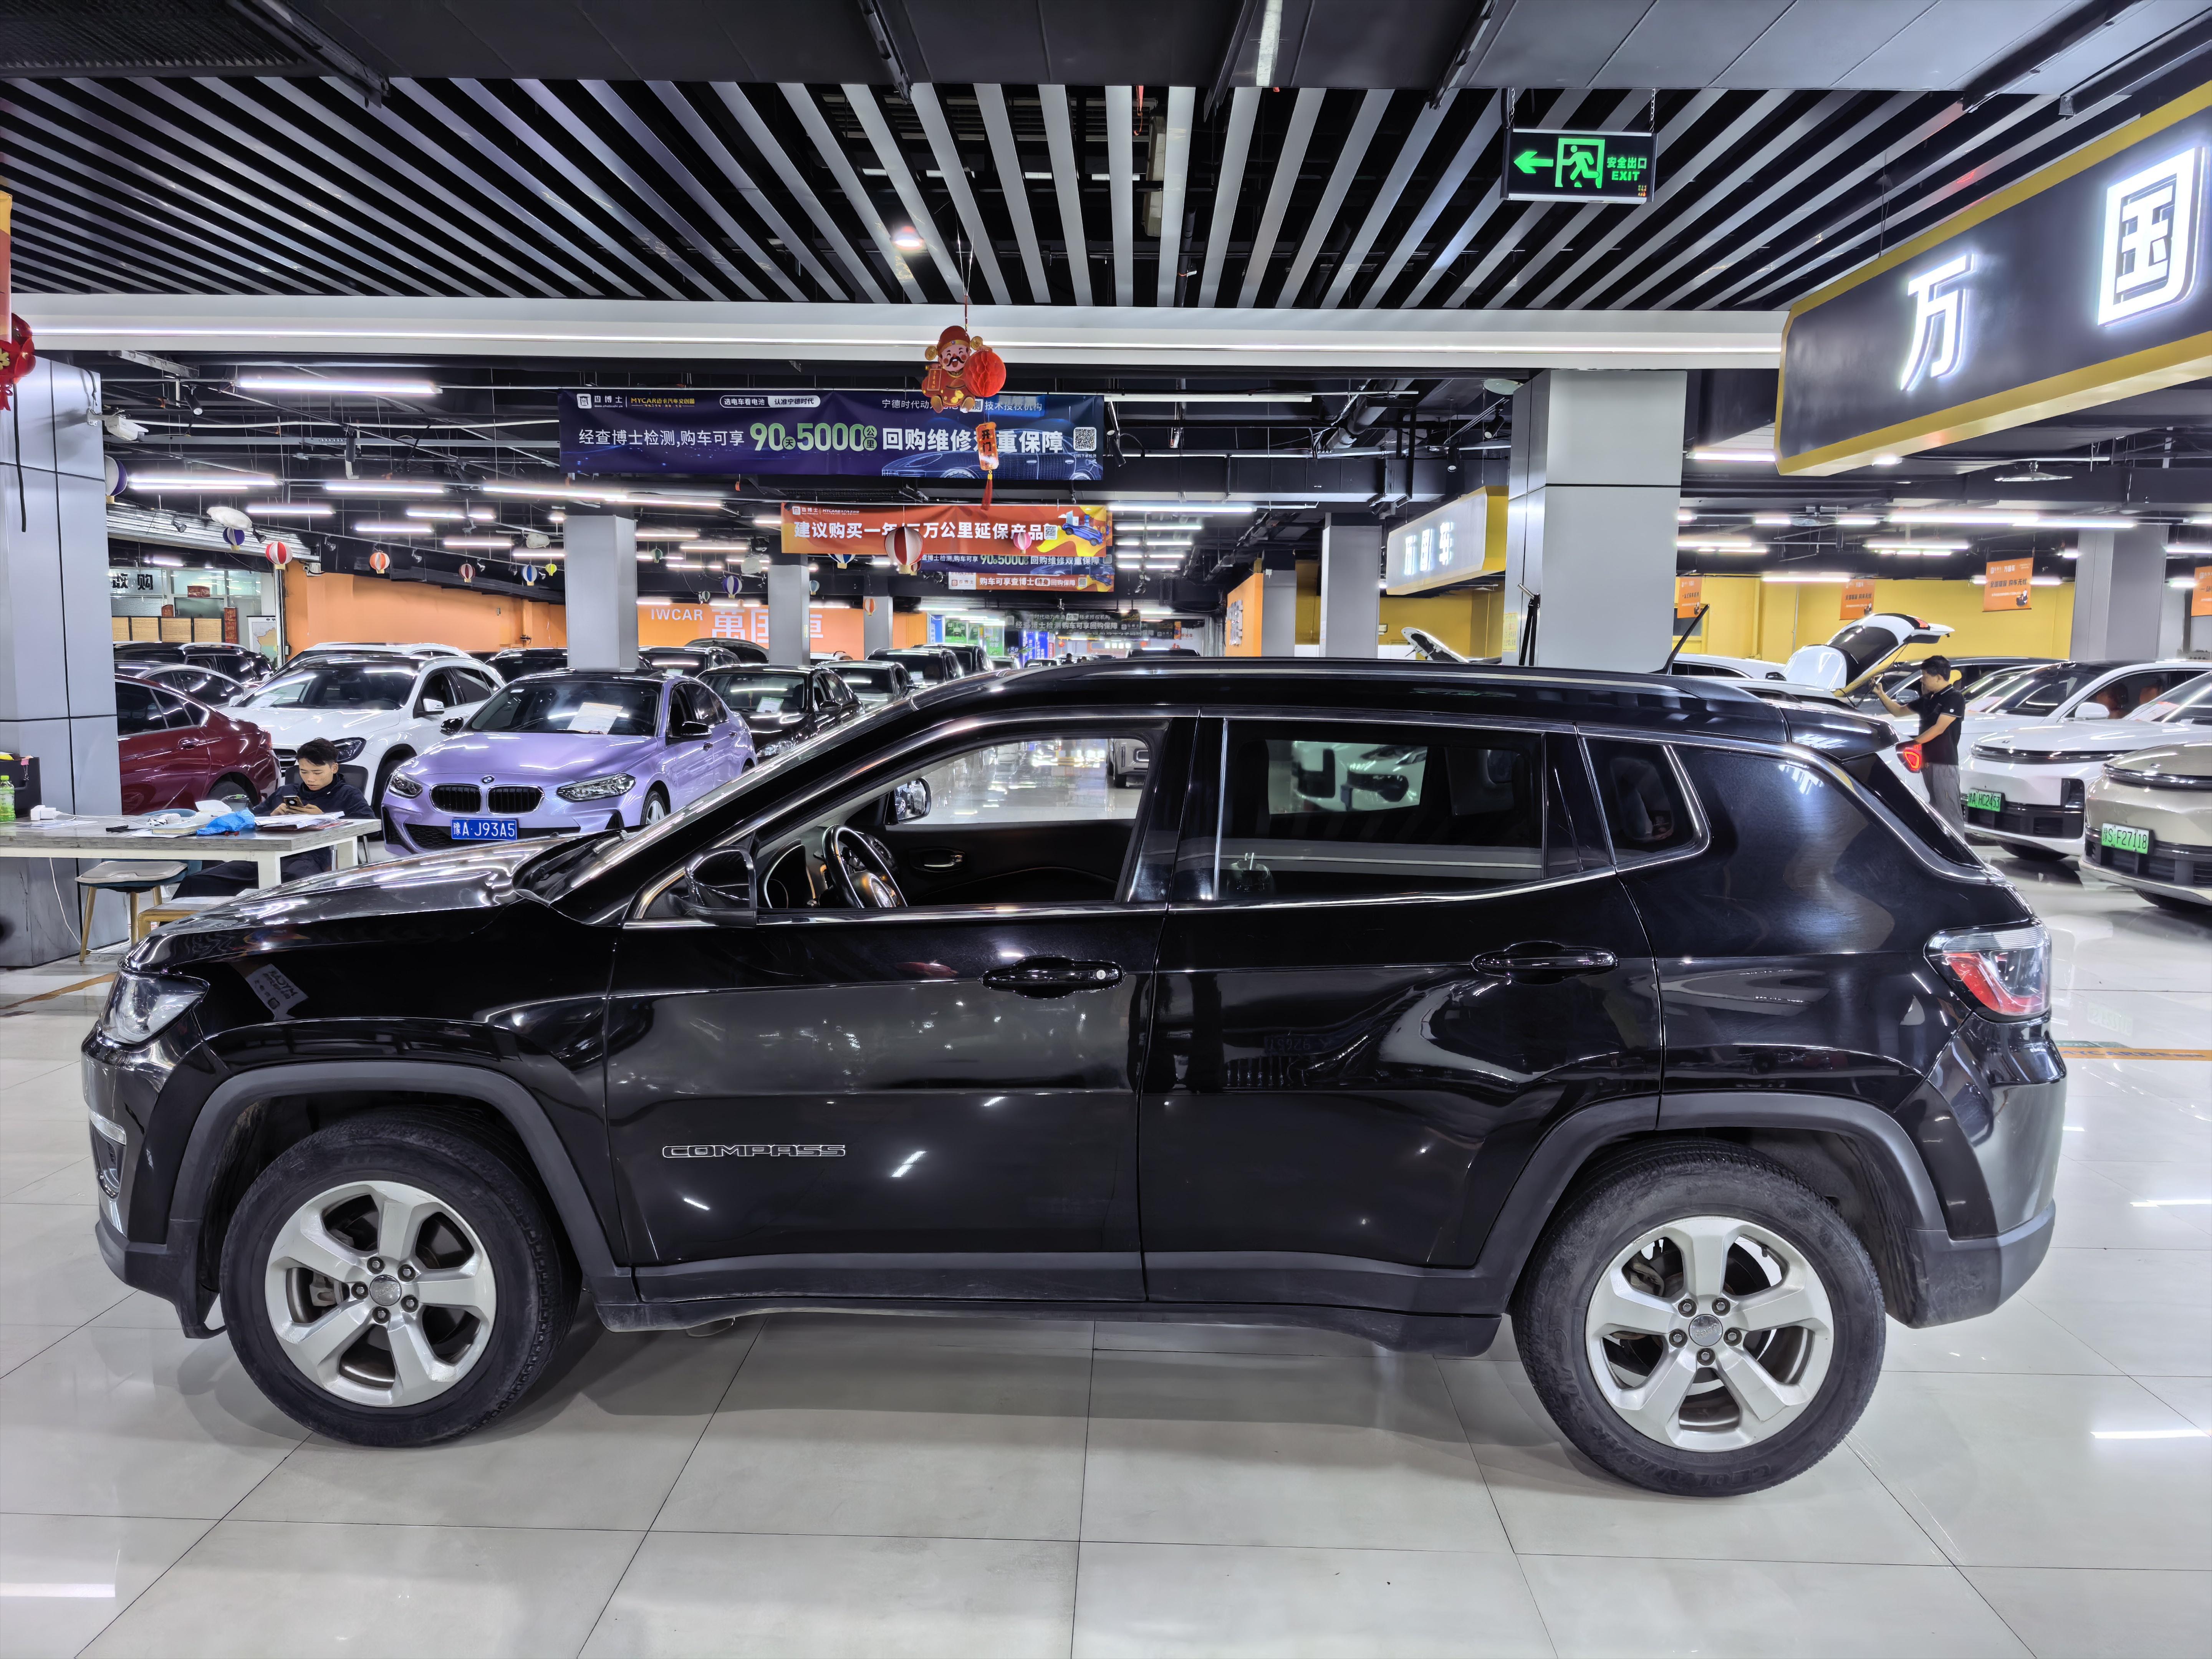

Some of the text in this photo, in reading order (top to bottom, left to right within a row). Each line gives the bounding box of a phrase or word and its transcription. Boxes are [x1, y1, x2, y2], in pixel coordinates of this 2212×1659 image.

[1607, 157, 1647, 169] 安全出口
[1612, 171, 1640, 181] EXIT
[1901, 146, 2206, 392] 万国
[883, 428, 1063, 454] 回购维修重保障
[651, 609, 704, 621] IWCAR
[662, 1144, 846, 1158] COMPASS
